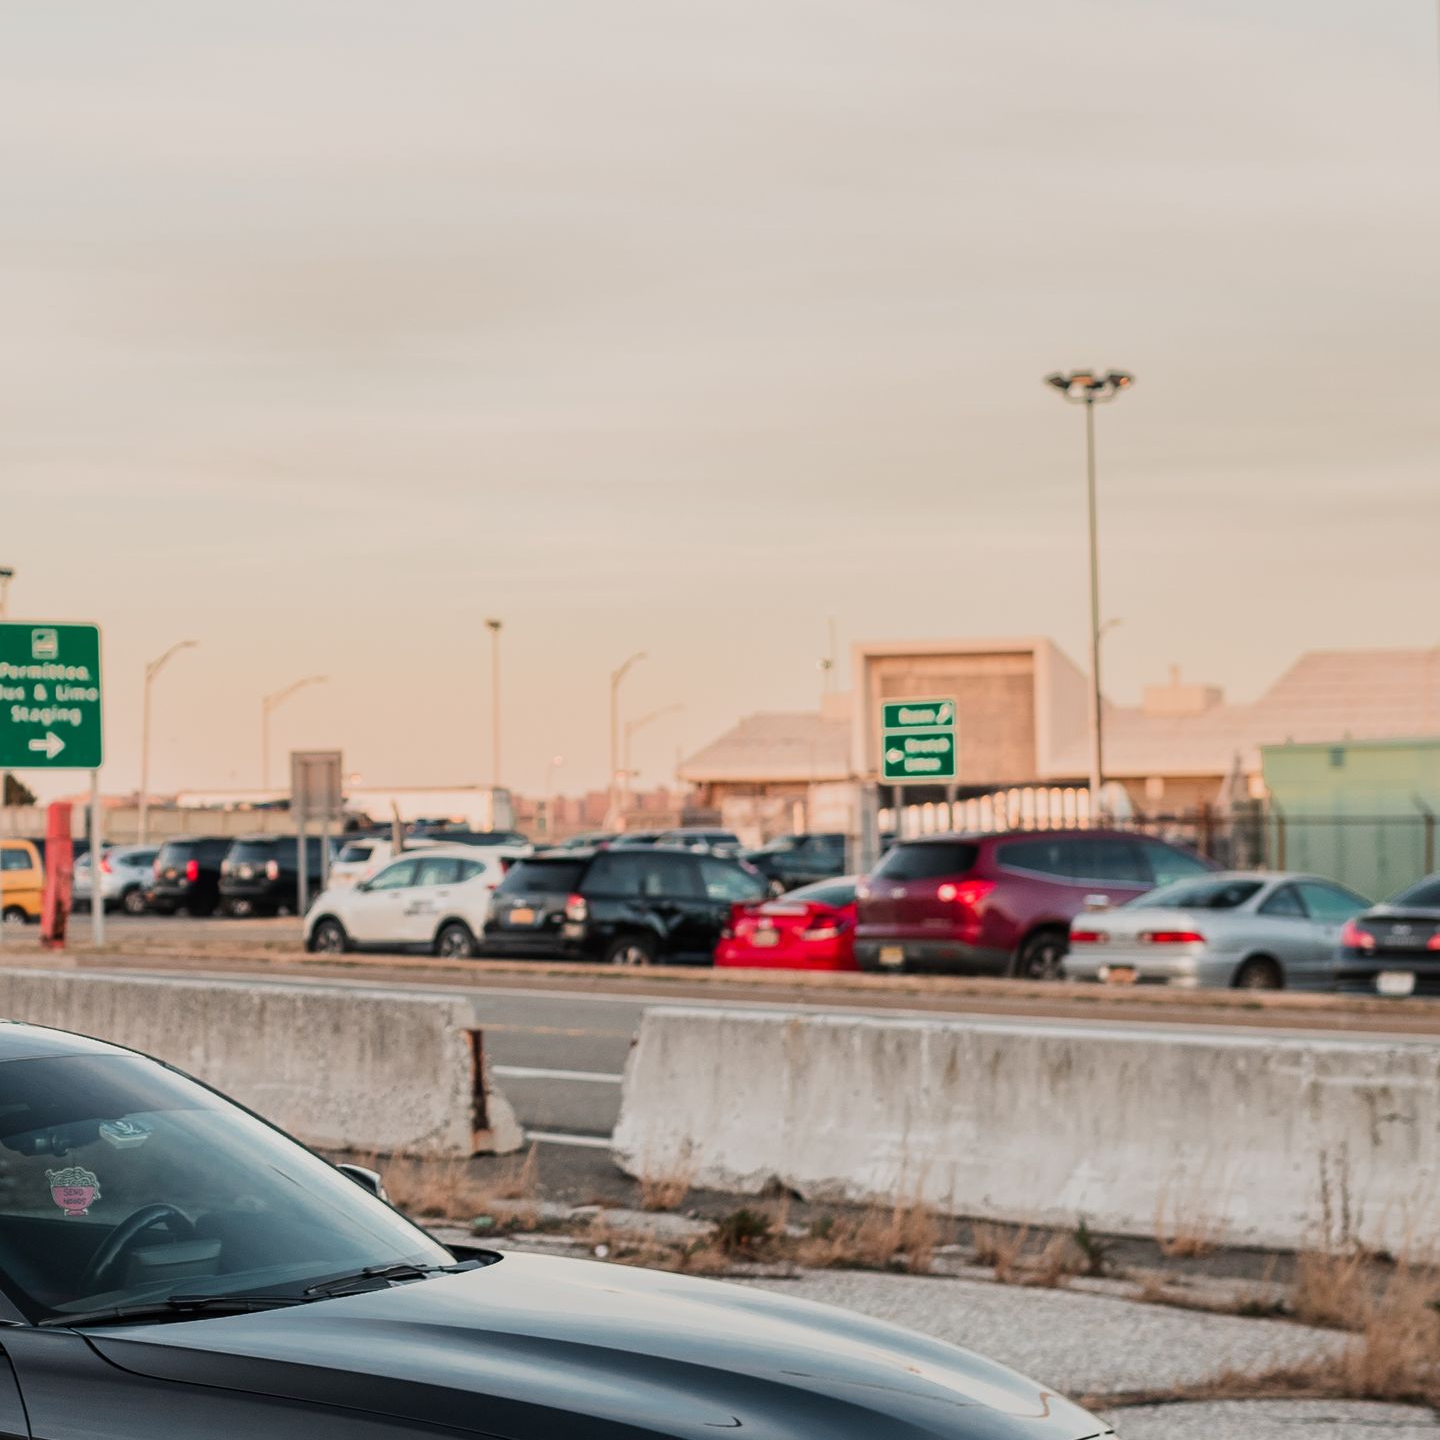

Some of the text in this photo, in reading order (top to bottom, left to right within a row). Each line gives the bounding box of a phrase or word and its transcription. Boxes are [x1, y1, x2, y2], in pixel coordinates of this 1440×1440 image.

[33, 684, 47, 701] &
[55, 684, 99, 702] Limo
[11, 705, 82, 726] Staging
[63, 1187, 84, 1196] SEND
